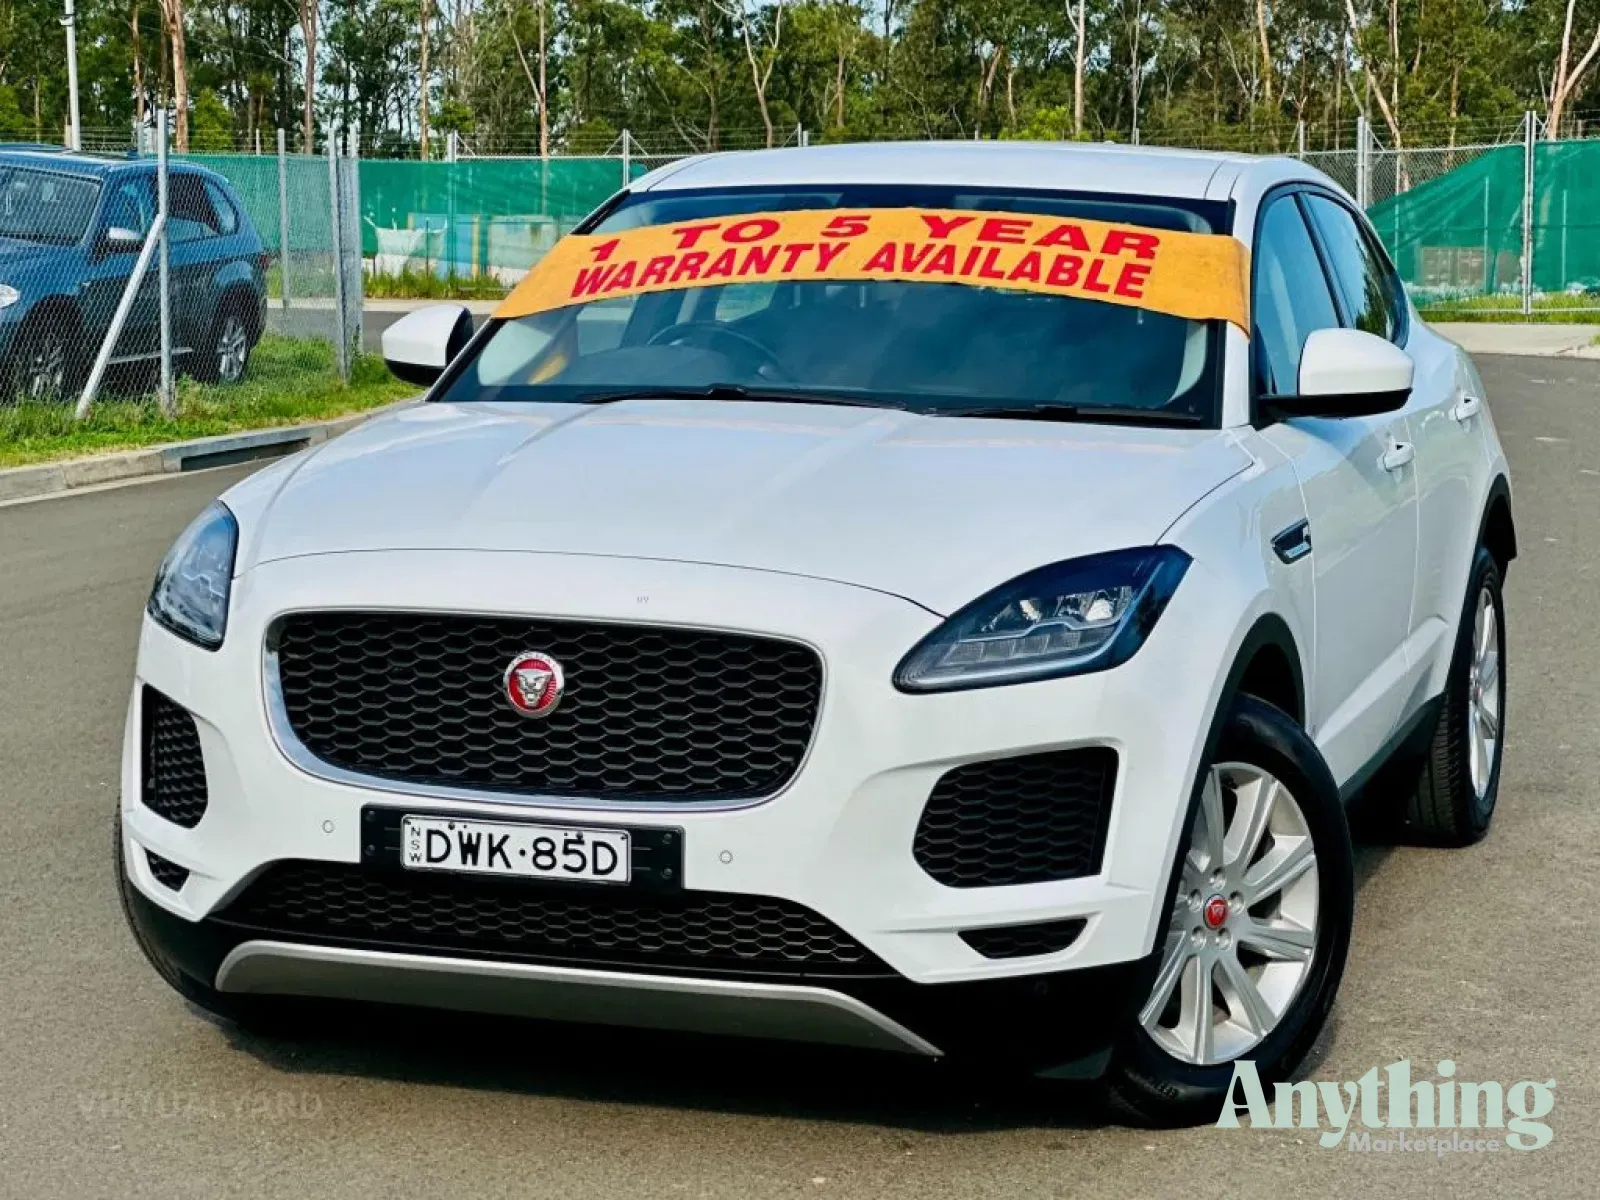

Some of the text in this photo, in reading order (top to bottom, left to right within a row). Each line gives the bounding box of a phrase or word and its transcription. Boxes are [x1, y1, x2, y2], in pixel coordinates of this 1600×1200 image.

[590, 214, 1161, 262] 1 TO 5 YEAR
[569, 241, 1152, 299] WARRANTY AVAILABLE
[409, 826, 422, 863] NSW
